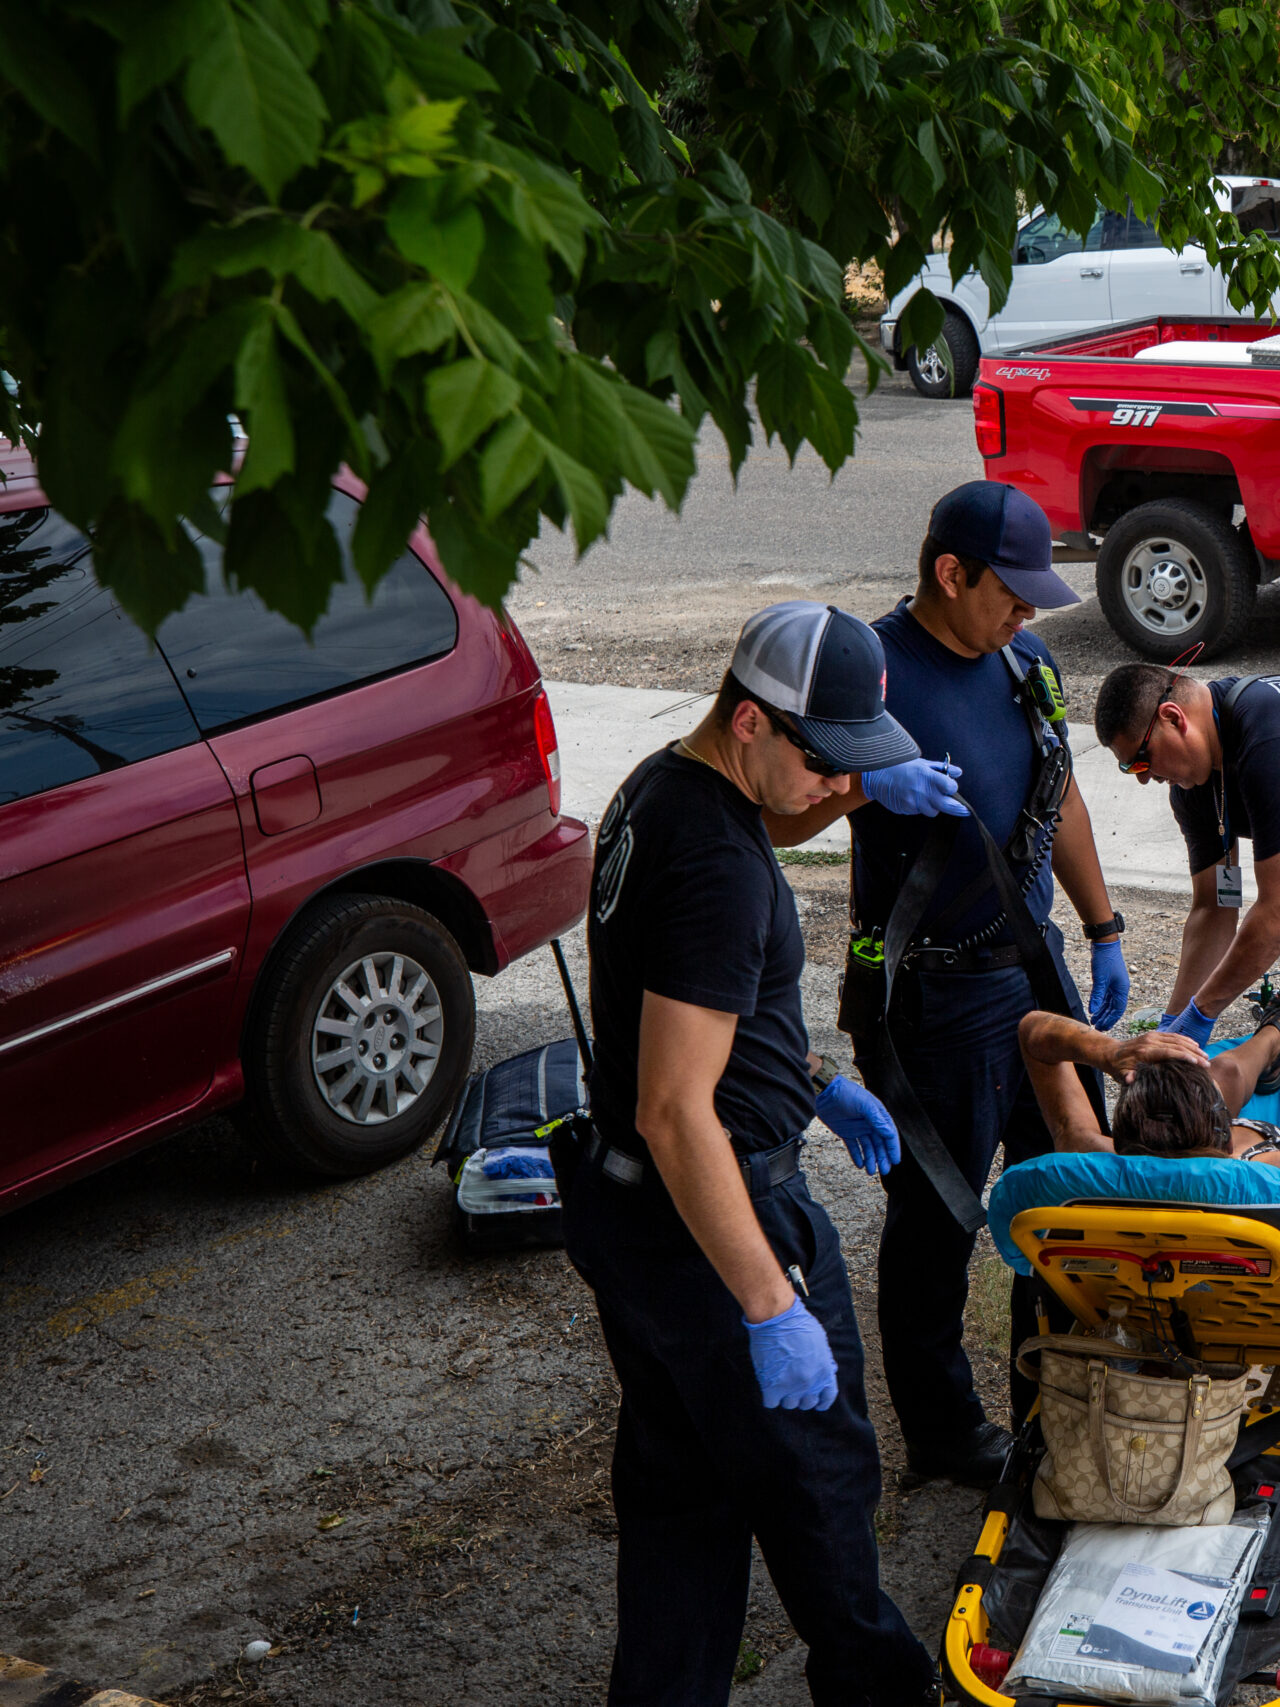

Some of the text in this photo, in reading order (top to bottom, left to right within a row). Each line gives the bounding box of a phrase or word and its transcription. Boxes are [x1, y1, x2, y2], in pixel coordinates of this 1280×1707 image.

[1109, 409, 1160, 427] 911
[1115, 1597, 1183, 1615] Transport Unit
[1120, 1586, 1188, 1608] DynaLift
